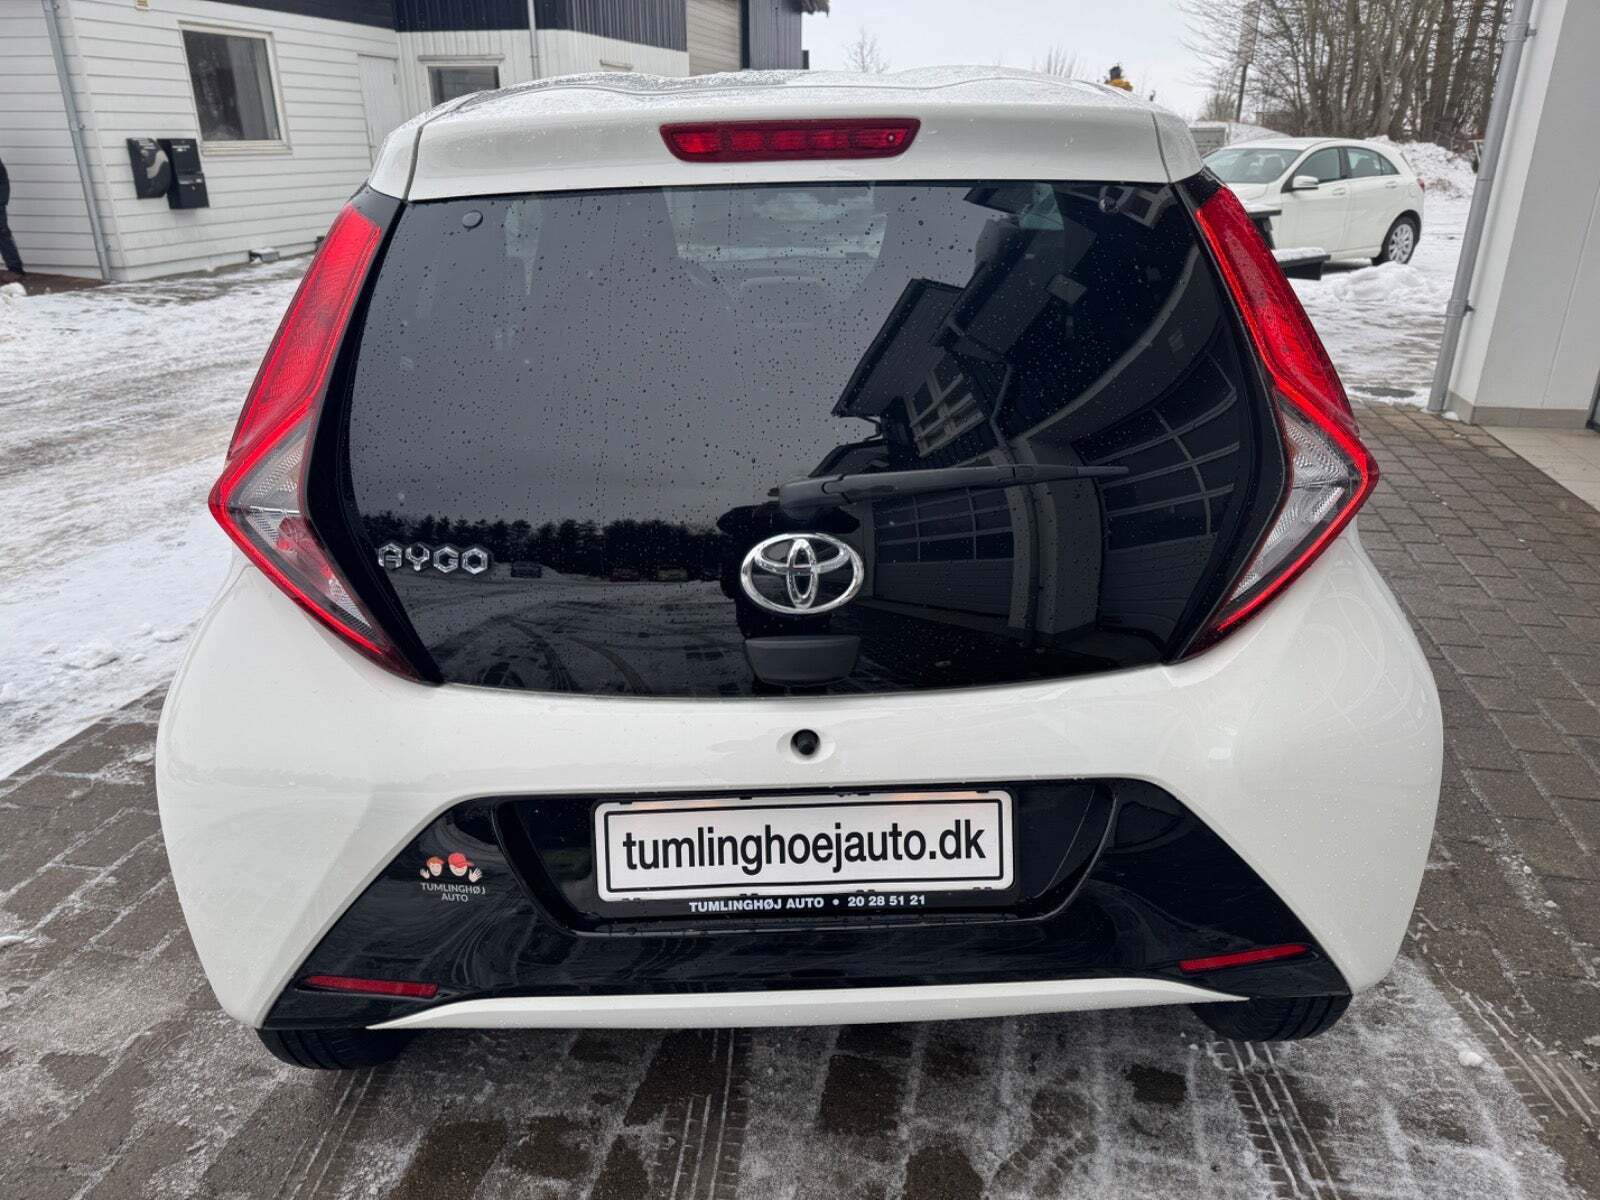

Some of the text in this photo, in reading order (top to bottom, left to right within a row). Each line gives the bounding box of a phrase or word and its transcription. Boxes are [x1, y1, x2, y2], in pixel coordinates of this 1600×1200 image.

[378, 543, 488, 575] AYGO
[622, 819, 987, 876] tumlinghoejauto.dk
[420, 883, 486, 895] TUMLINGHØJ
[441, 893, 468, 902] AUTO
[688, 895, 926, 913] TUMLINGHØJ AUTO 20 28 51 21
